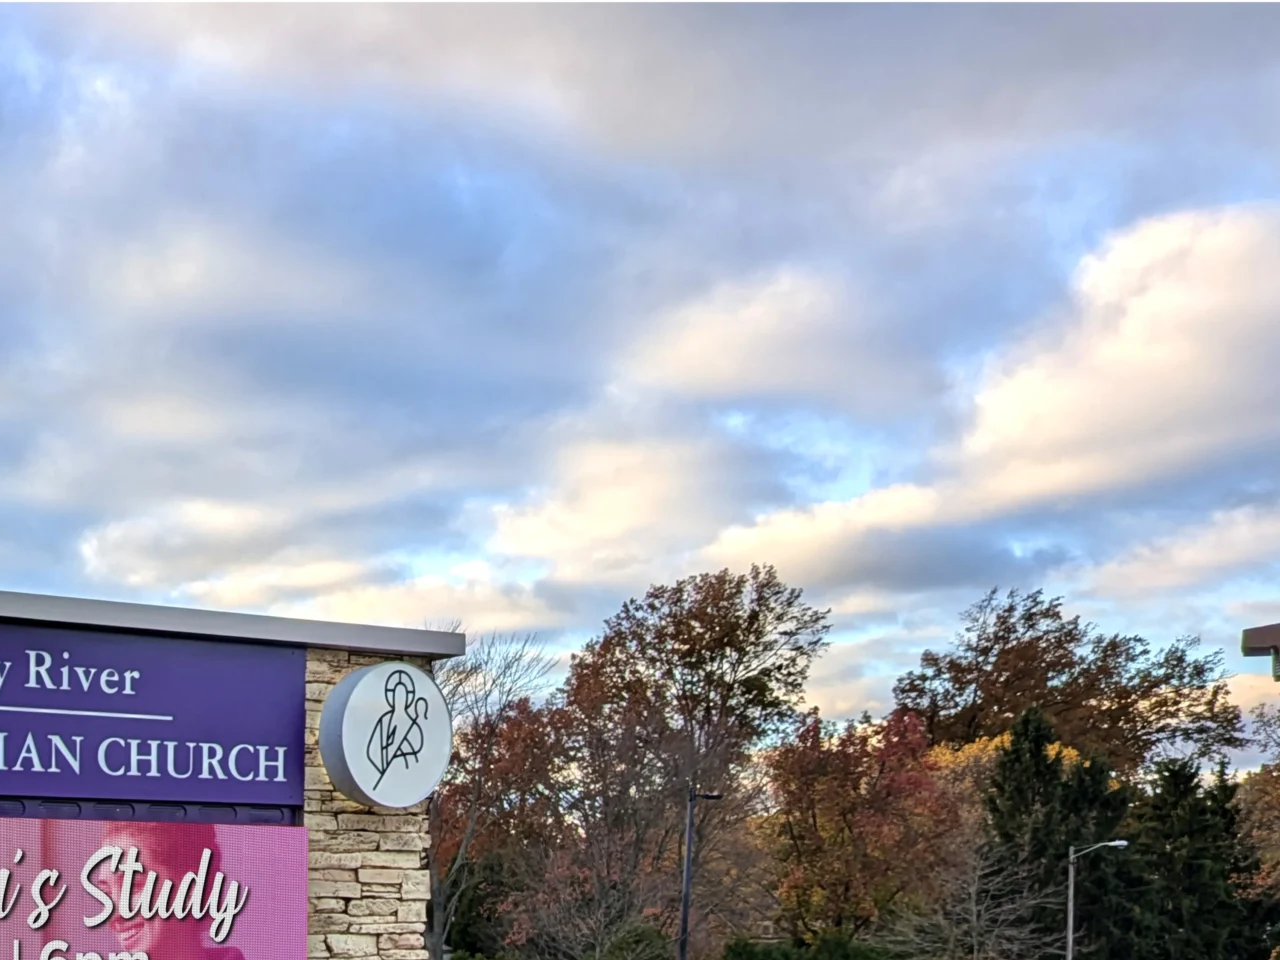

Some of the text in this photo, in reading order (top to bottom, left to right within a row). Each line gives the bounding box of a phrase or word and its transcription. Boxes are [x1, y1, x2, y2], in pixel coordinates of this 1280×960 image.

[24, 648, 141, 696] River
[96, 737, 289, 783] CHURCH
[78, 836, 248, 942] Study
